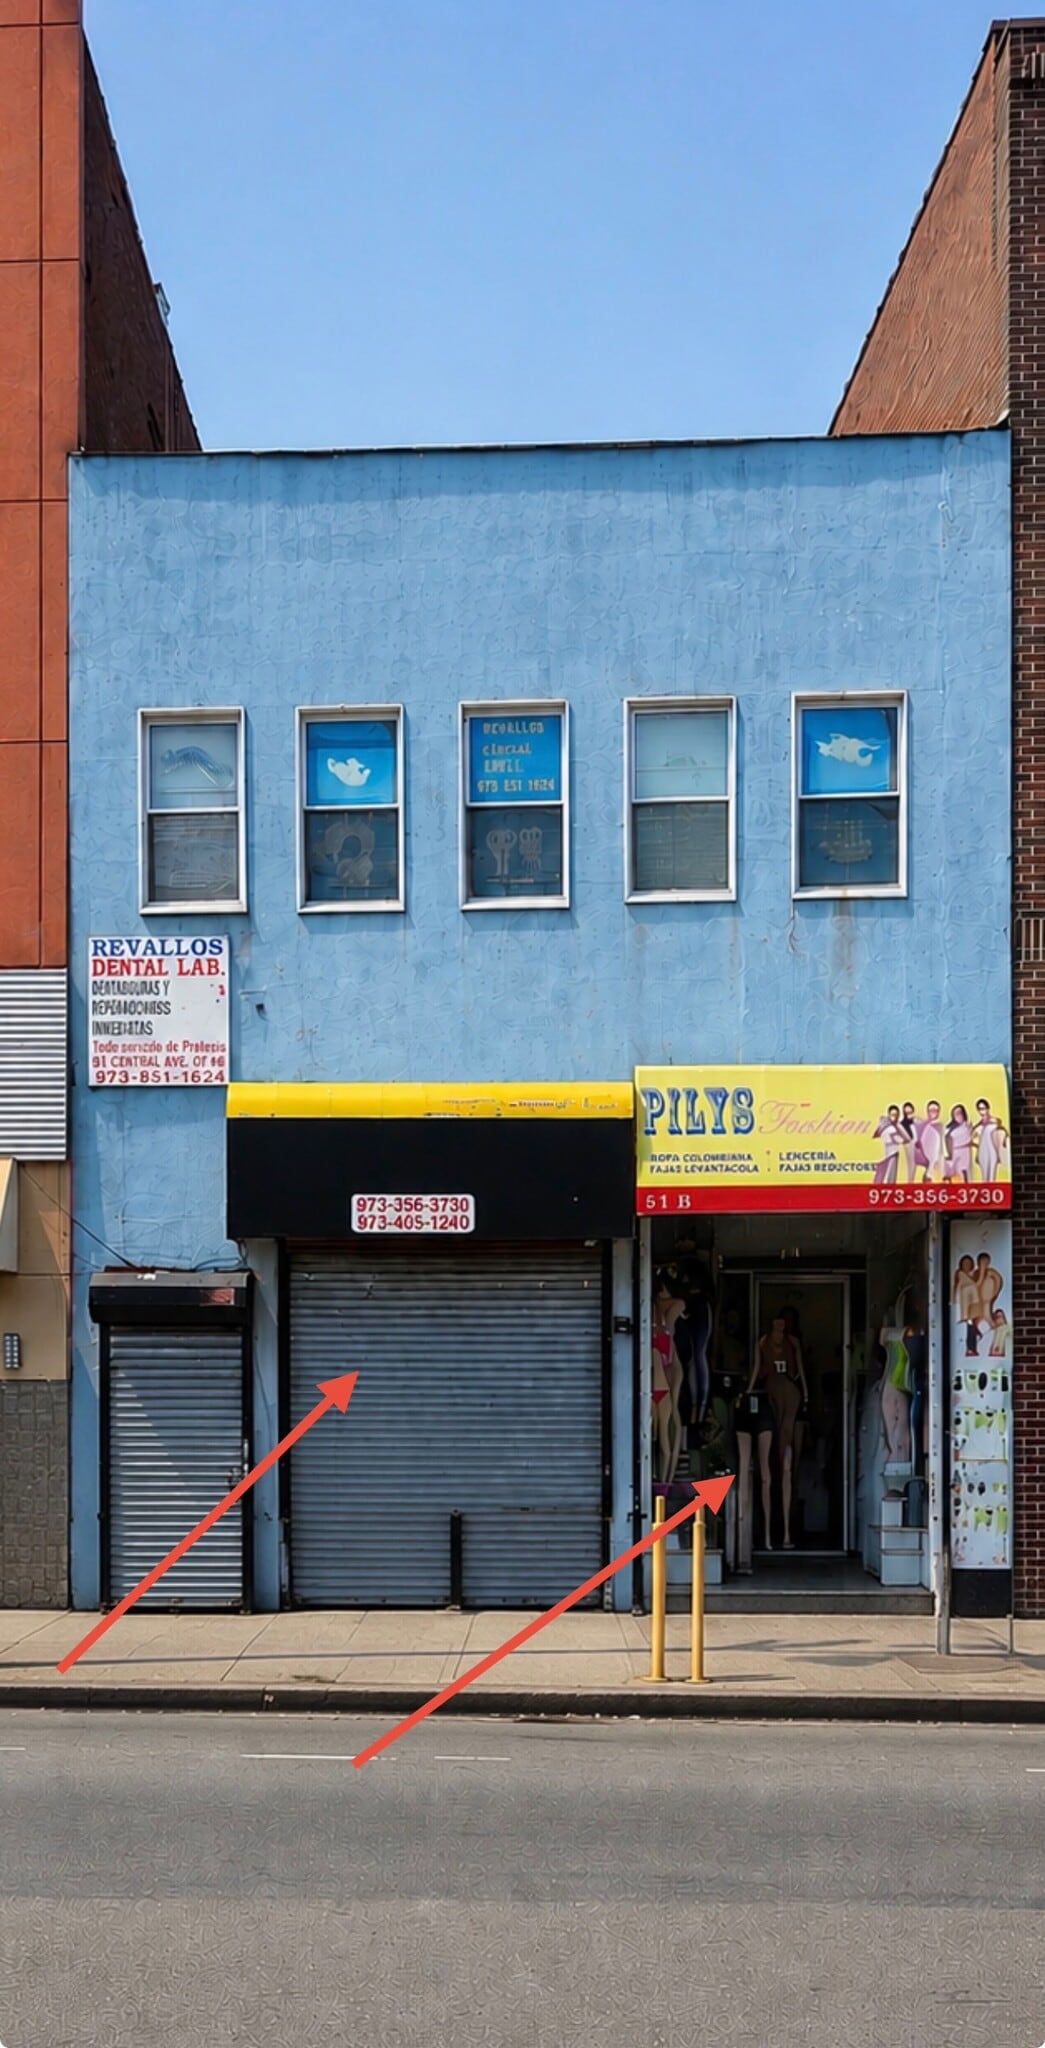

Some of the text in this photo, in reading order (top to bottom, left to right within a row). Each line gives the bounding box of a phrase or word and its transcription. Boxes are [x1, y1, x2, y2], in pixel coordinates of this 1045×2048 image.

[92, 938, 223, 957] REVALLOS
[92, 958, 226, 976] DENTAL LAB.
[166, 1041, 178, 1053] de
[110, 1056, 160, 1067] CENTRAL
[95, 1070, 225, 1083] 973-851-1624
[641, 1087, 755, 1135] PILYS
[650, 1154, 680, 1162] ROPA
[650, 1165, 681, 1173] FAJAS
[779, 1163, 810, 1172] FAJAS
[677, 1194, 691, 1209] B
[868, 1188, 1004, 1204] 973-356-3730
[356, 1197, 470, 1213] 973-356-3730
[356, 1214, 470, 1230] 973-405-1240
